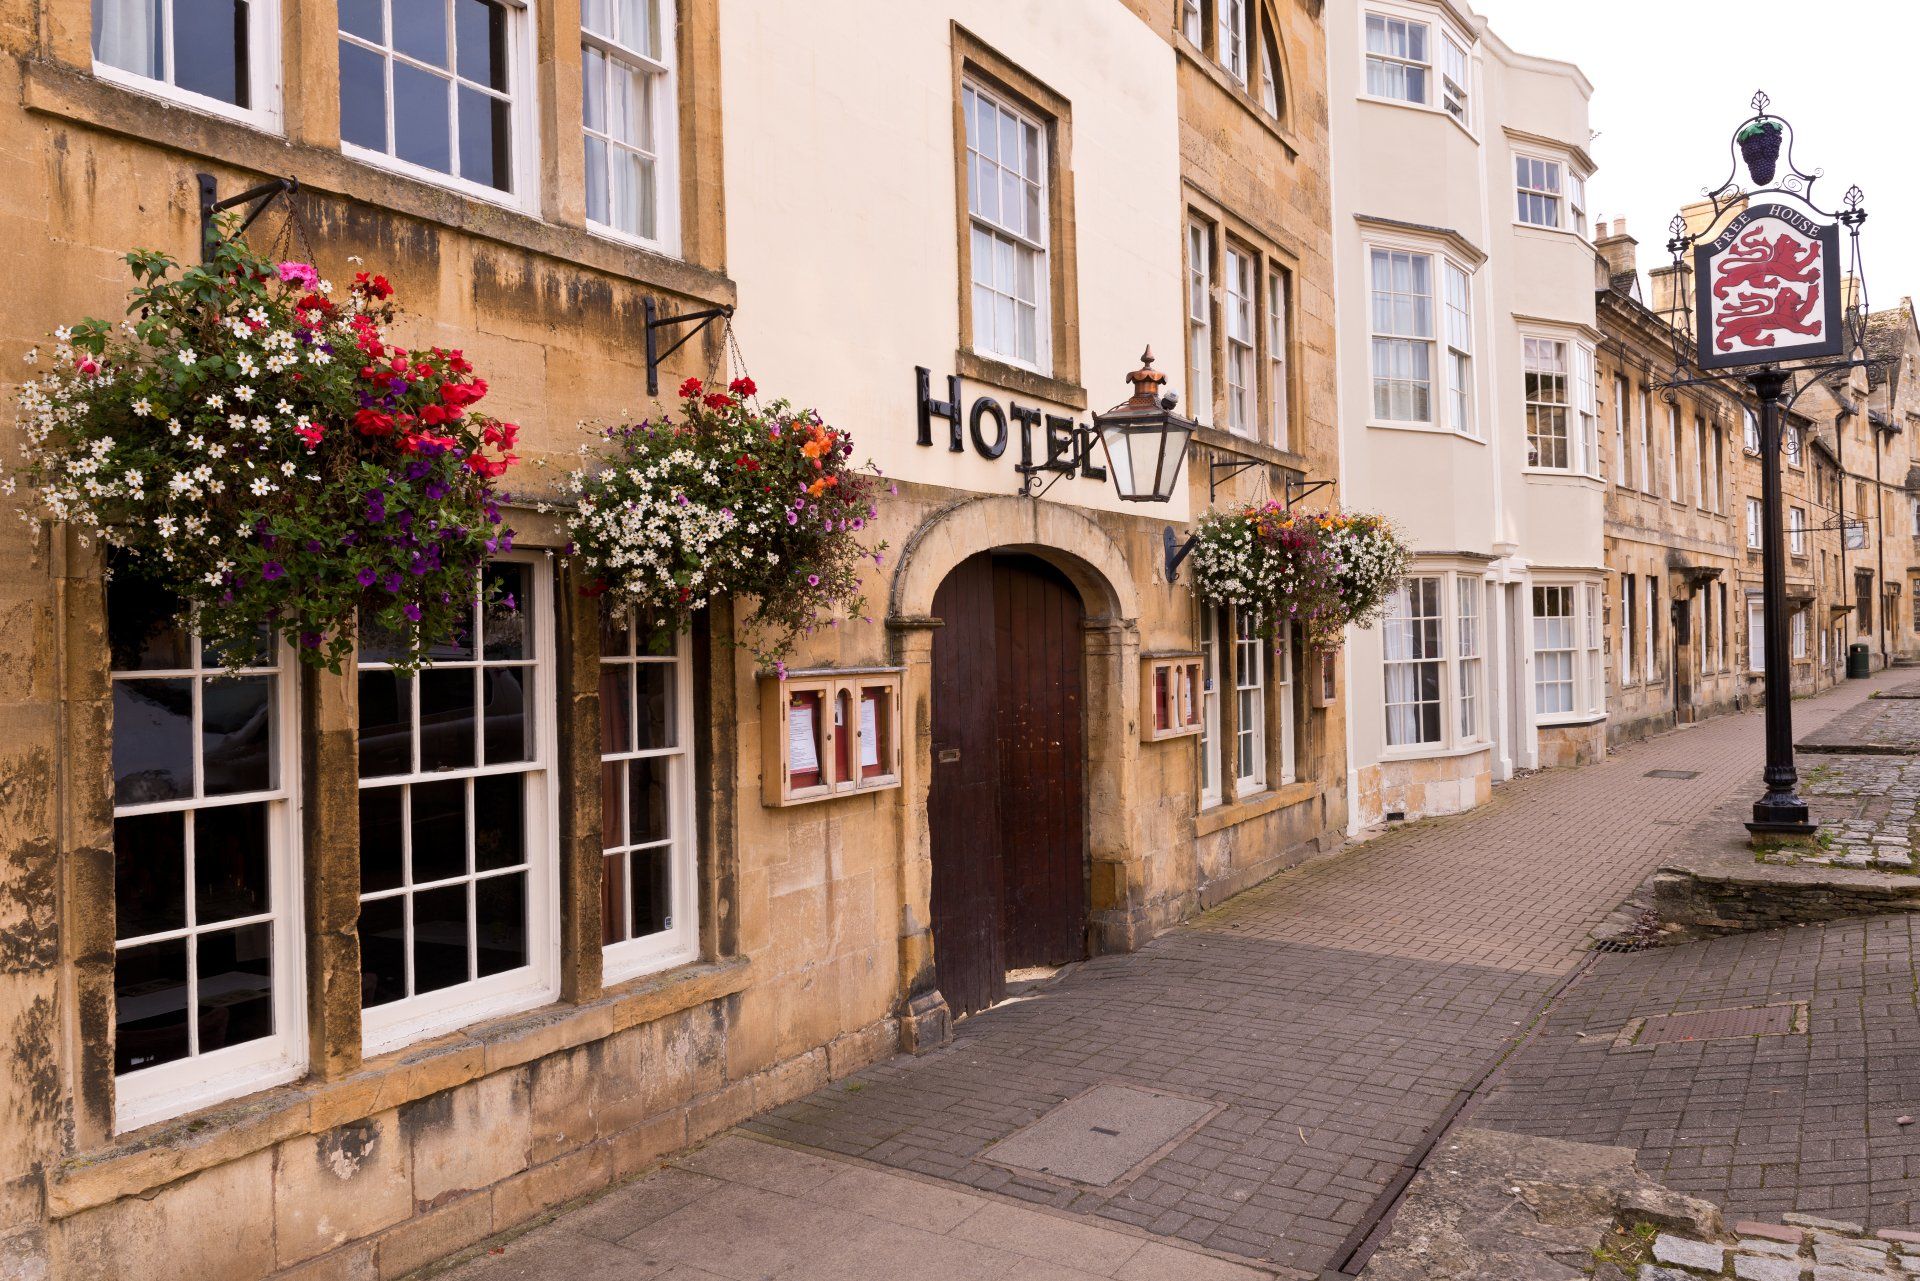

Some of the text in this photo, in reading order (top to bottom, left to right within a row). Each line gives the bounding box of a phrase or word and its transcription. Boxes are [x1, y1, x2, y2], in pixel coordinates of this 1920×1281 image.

[1713, 204, 1821, 251] FREE HOUSE
[915, 365, 1107, 483] HOTEL
